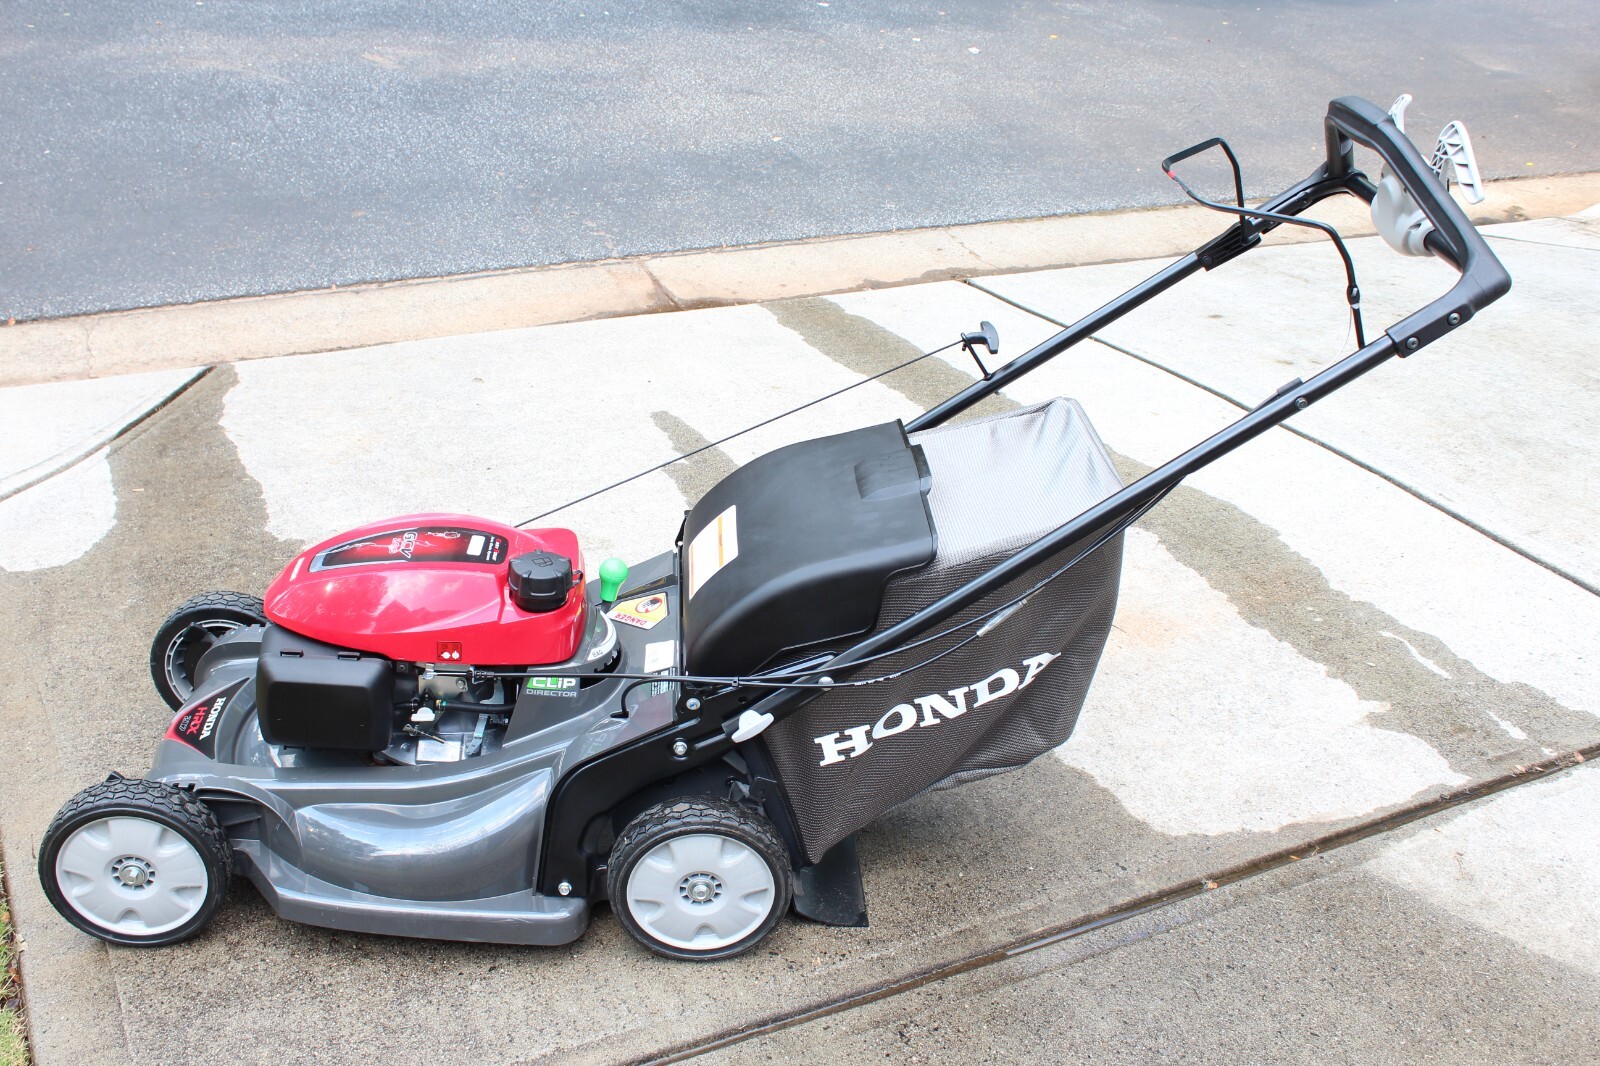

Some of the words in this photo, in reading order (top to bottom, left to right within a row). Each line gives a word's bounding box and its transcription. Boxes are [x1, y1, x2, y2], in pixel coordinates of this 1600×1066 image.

[400, 531, 417, 558] GCV
[614, 612, 647, 626] DANGER
[526, 689, 577, 698] DIRECTOR
[186, 706, 208, 735] HRX
[199, 696, 227, 740] HONDA
[814, 652, 1062, 767] HONDA
